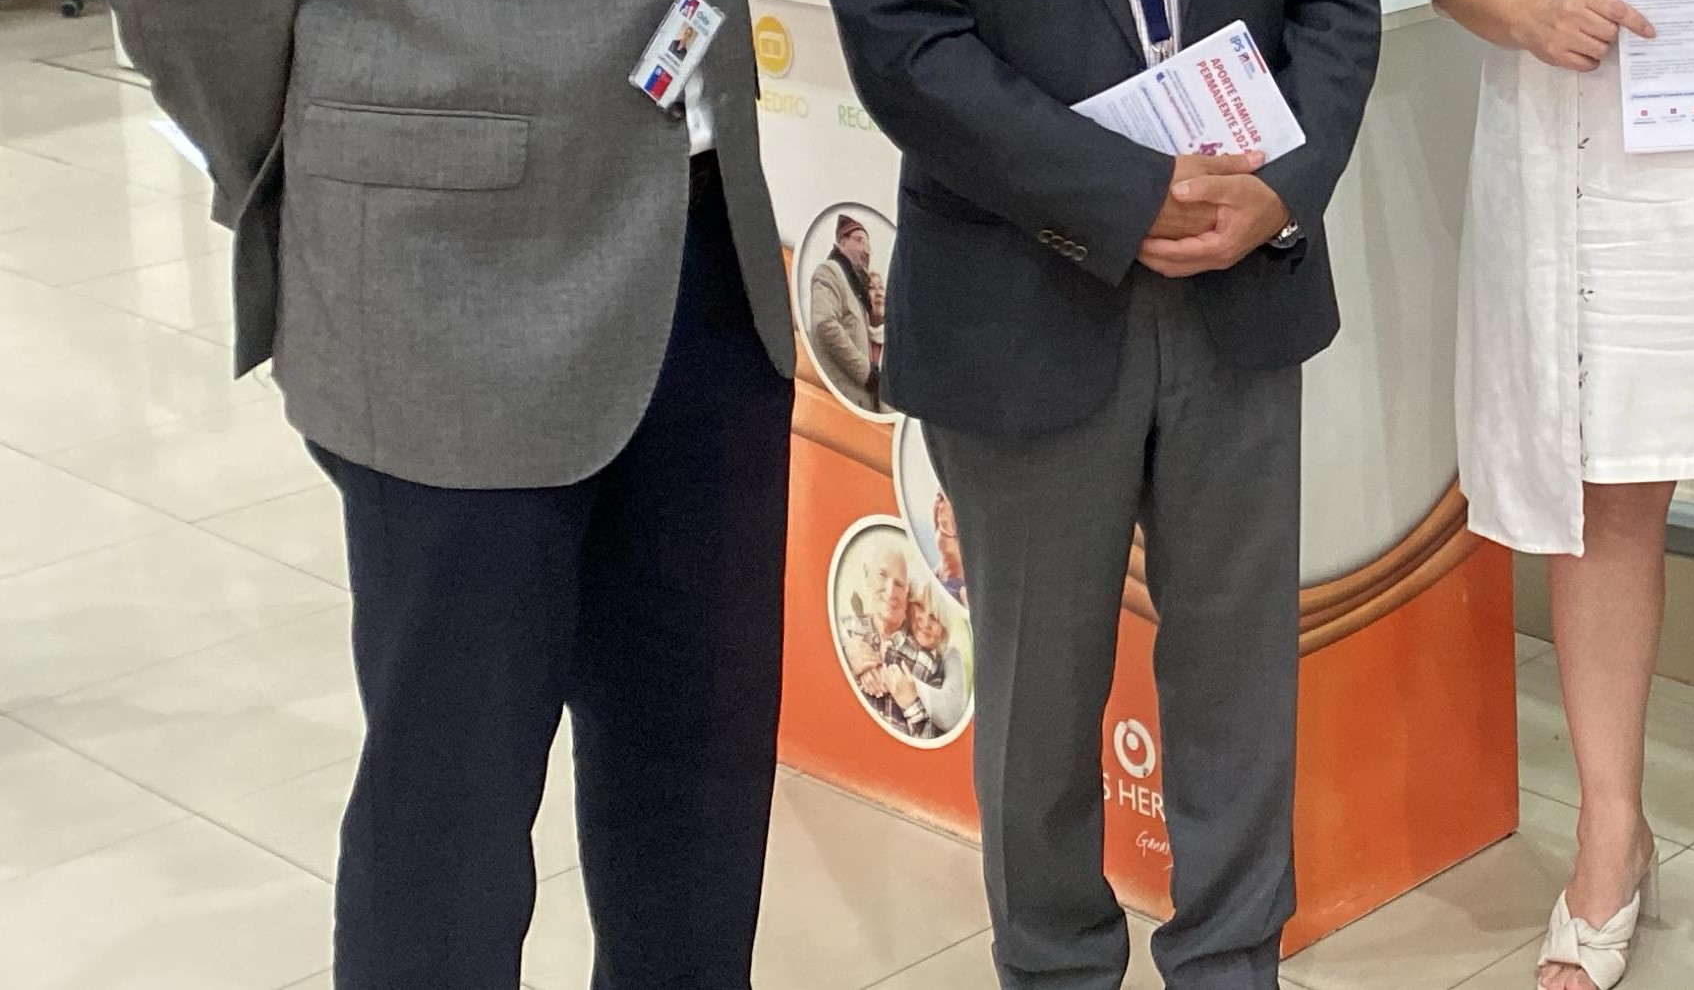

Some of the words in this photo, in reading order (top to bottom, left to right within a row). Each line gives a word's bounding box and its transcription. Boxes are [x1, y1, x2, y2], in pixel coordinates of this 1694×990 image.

[1229, 35, 1245, 52] IPS
[1196, 60, 1240, 130] PERMANENTE
[1210, 57, 1238, 94] APORTE
[1233, 92, 1262, 145] FAMILIAR
